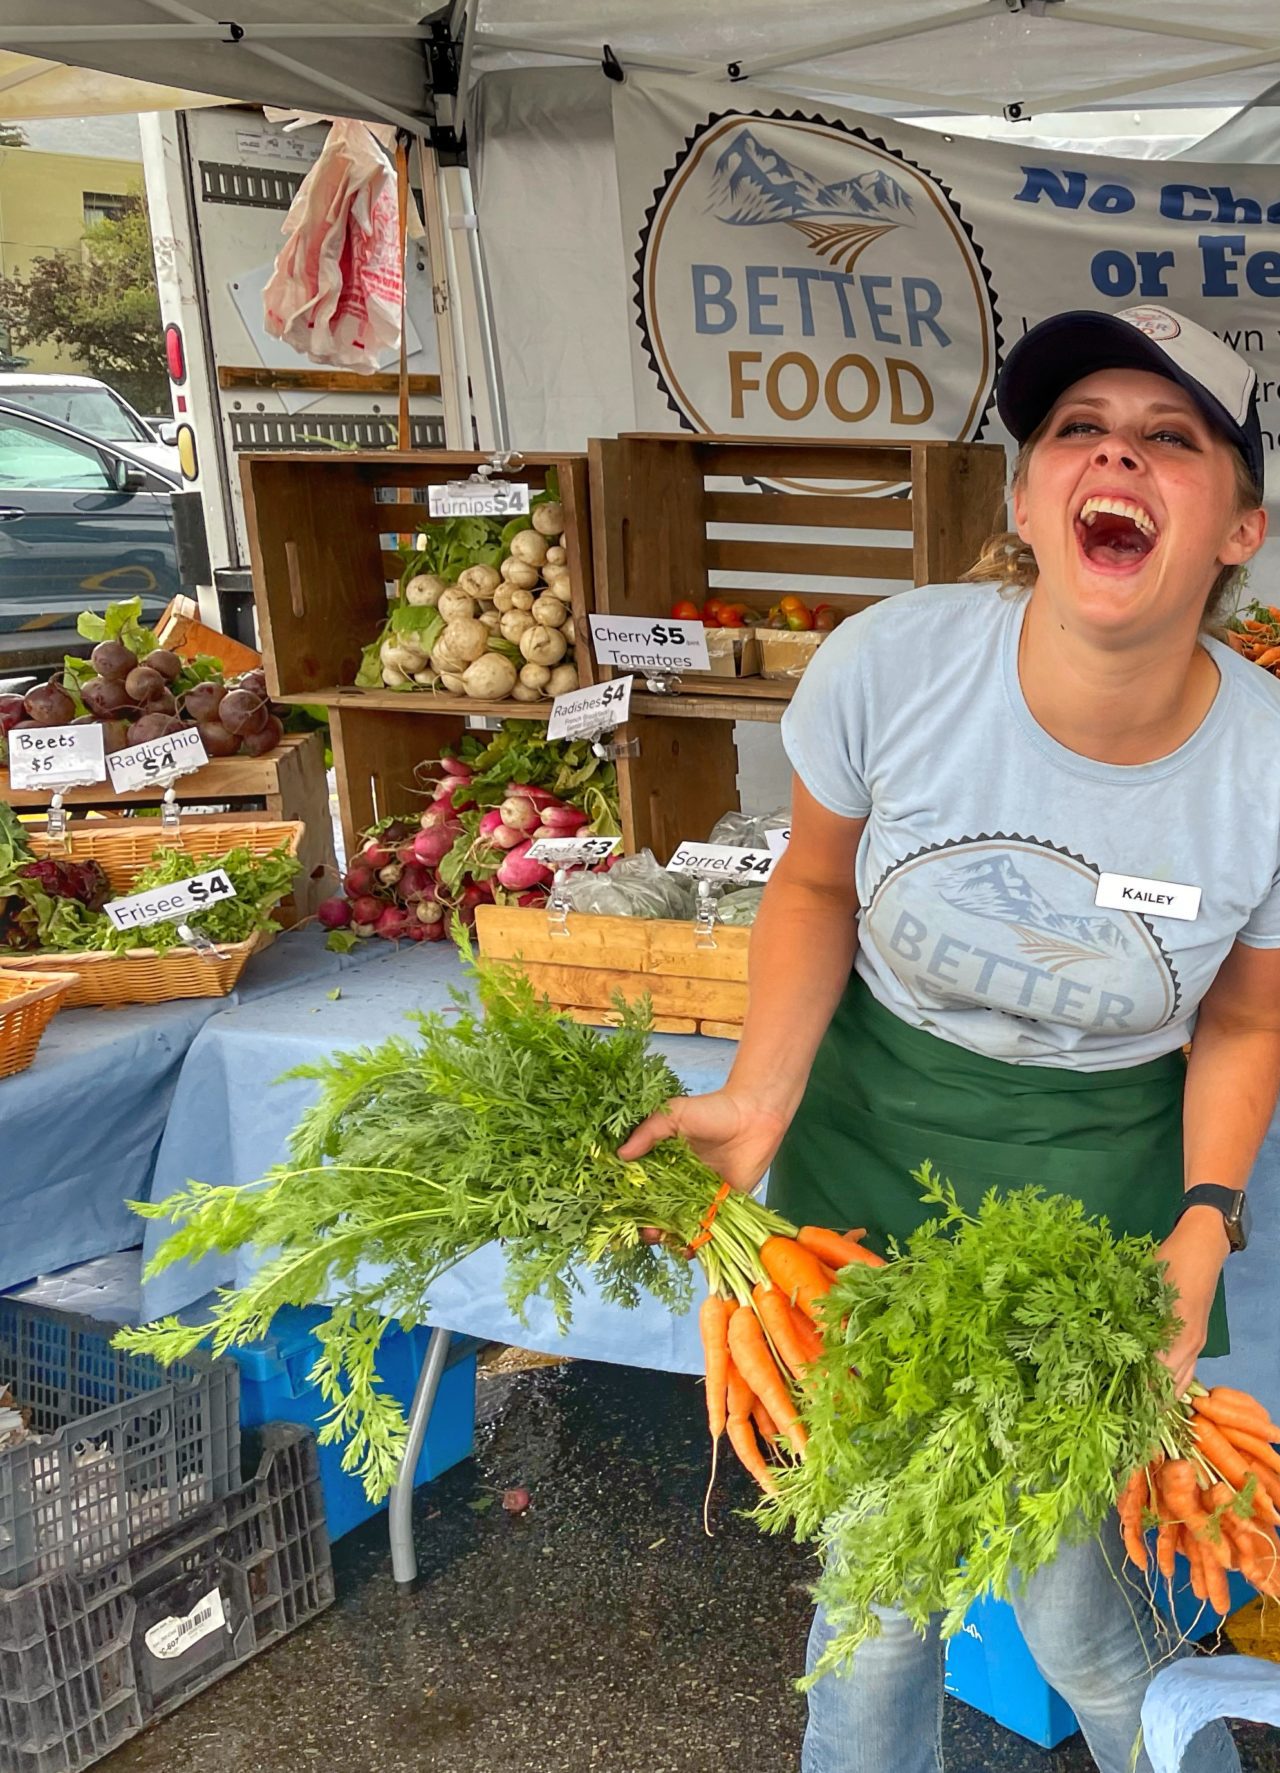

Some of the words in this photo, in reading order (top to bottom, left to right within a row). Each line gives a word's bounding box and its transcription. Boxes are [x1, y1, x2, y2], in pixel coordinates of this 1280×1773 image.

[1014, 166, 1136, 213] No
[1090, 249, 1175, 297] or
[691, 264, 952, 348] BETTER
[728, 351, 935, 425] FOOD
[431, 496, 493, 516] Turnips
[493, 489, 523, 513] $4
[594, 627, 651, 646] Cherry
[651, 624, 685, 646] $5
[608, 650, 692, 667] Tomatoes
[554, 698, 601, 718] Radishes
[602, 684, 625, 707] $4
[17, 734, 75, 750] Beets
[109, 732, 200, 771] Radicchio
[31, 755, 54, 772] $5
[142, 752, 177, 777] $4
[579, 839, 613, 855] $3
[672, 851, 733, 870] Sorrel
[735, 853, 773, 874] $4
[114, 894, 185, 925] Frisee
[187, 876, 229, 902] $4
[1122, 887, 1175, 906] KAILEY
[889, 910, 1136, 1029] BETTER
